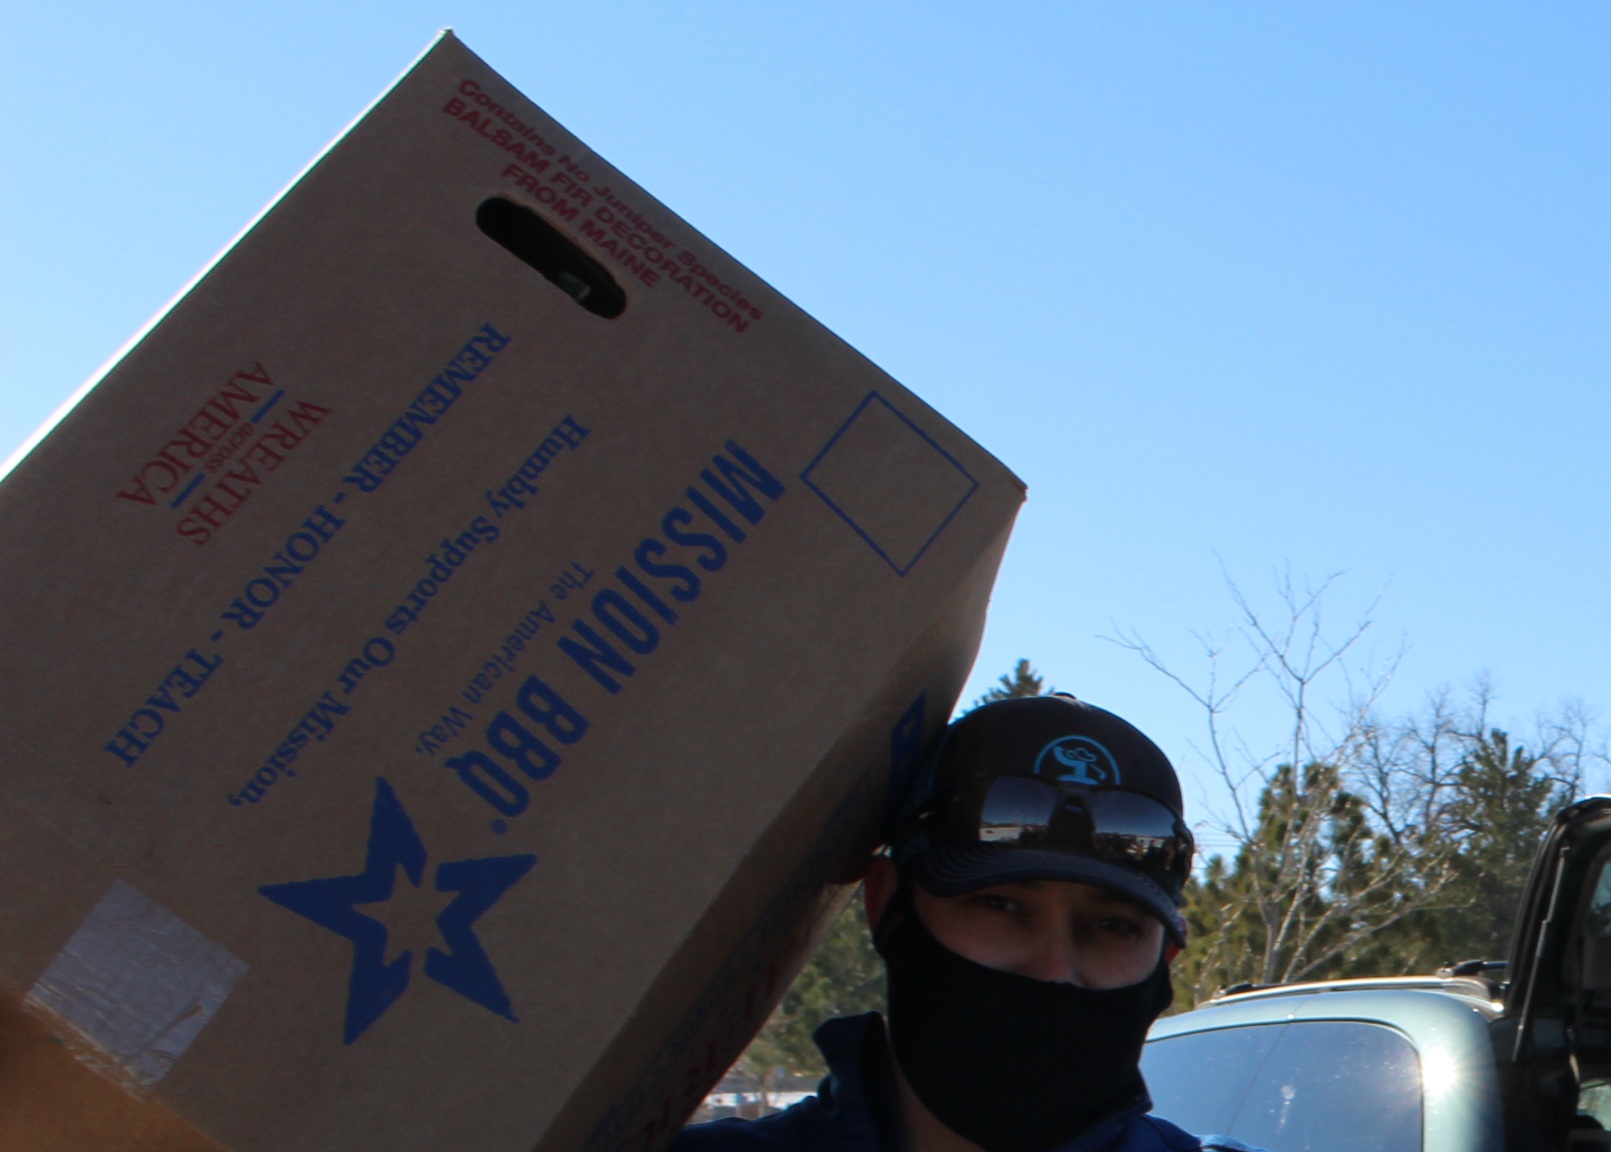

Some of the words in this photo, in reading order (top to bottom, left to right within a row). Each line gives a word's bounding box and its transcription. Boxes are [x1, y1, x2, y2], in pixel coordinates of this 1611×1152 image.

[441, 98, 557, 184] BALSAM
[556, 171, 593, 207] FIR
[593, 203, 751, 333] DECORATION
[458, 79, 559, 155] Contains
[559, 153, 592, 183] No
[594, 184, 676, 252] Juniper
[679, 250, 764, 321] Species
[501, 163, 578, 221] FROM
[580, 218, 662, 288] MAINE
[116, 362, 275, 508] AMERICA
[342, 323, 512, 493] REMEMBER
[482, 414, 591, 511] Humbly
[177, 400, 330, 546] WREATHS
[220, 508, 346, 632] HONOR
[384, 514, 500, 635] Supports
[550, 561, 594, 600] The
[556, 438, 786, 695] MISSION
[104, 648, 223, 768] TEACH
[337, 637, 398, 696] Our
[463, 599, 555, 705] American
[228, 691, 351, 807] Mission,
[415, 707, 473, 755] Way.
[443, 674, 591, 819] BBQ
